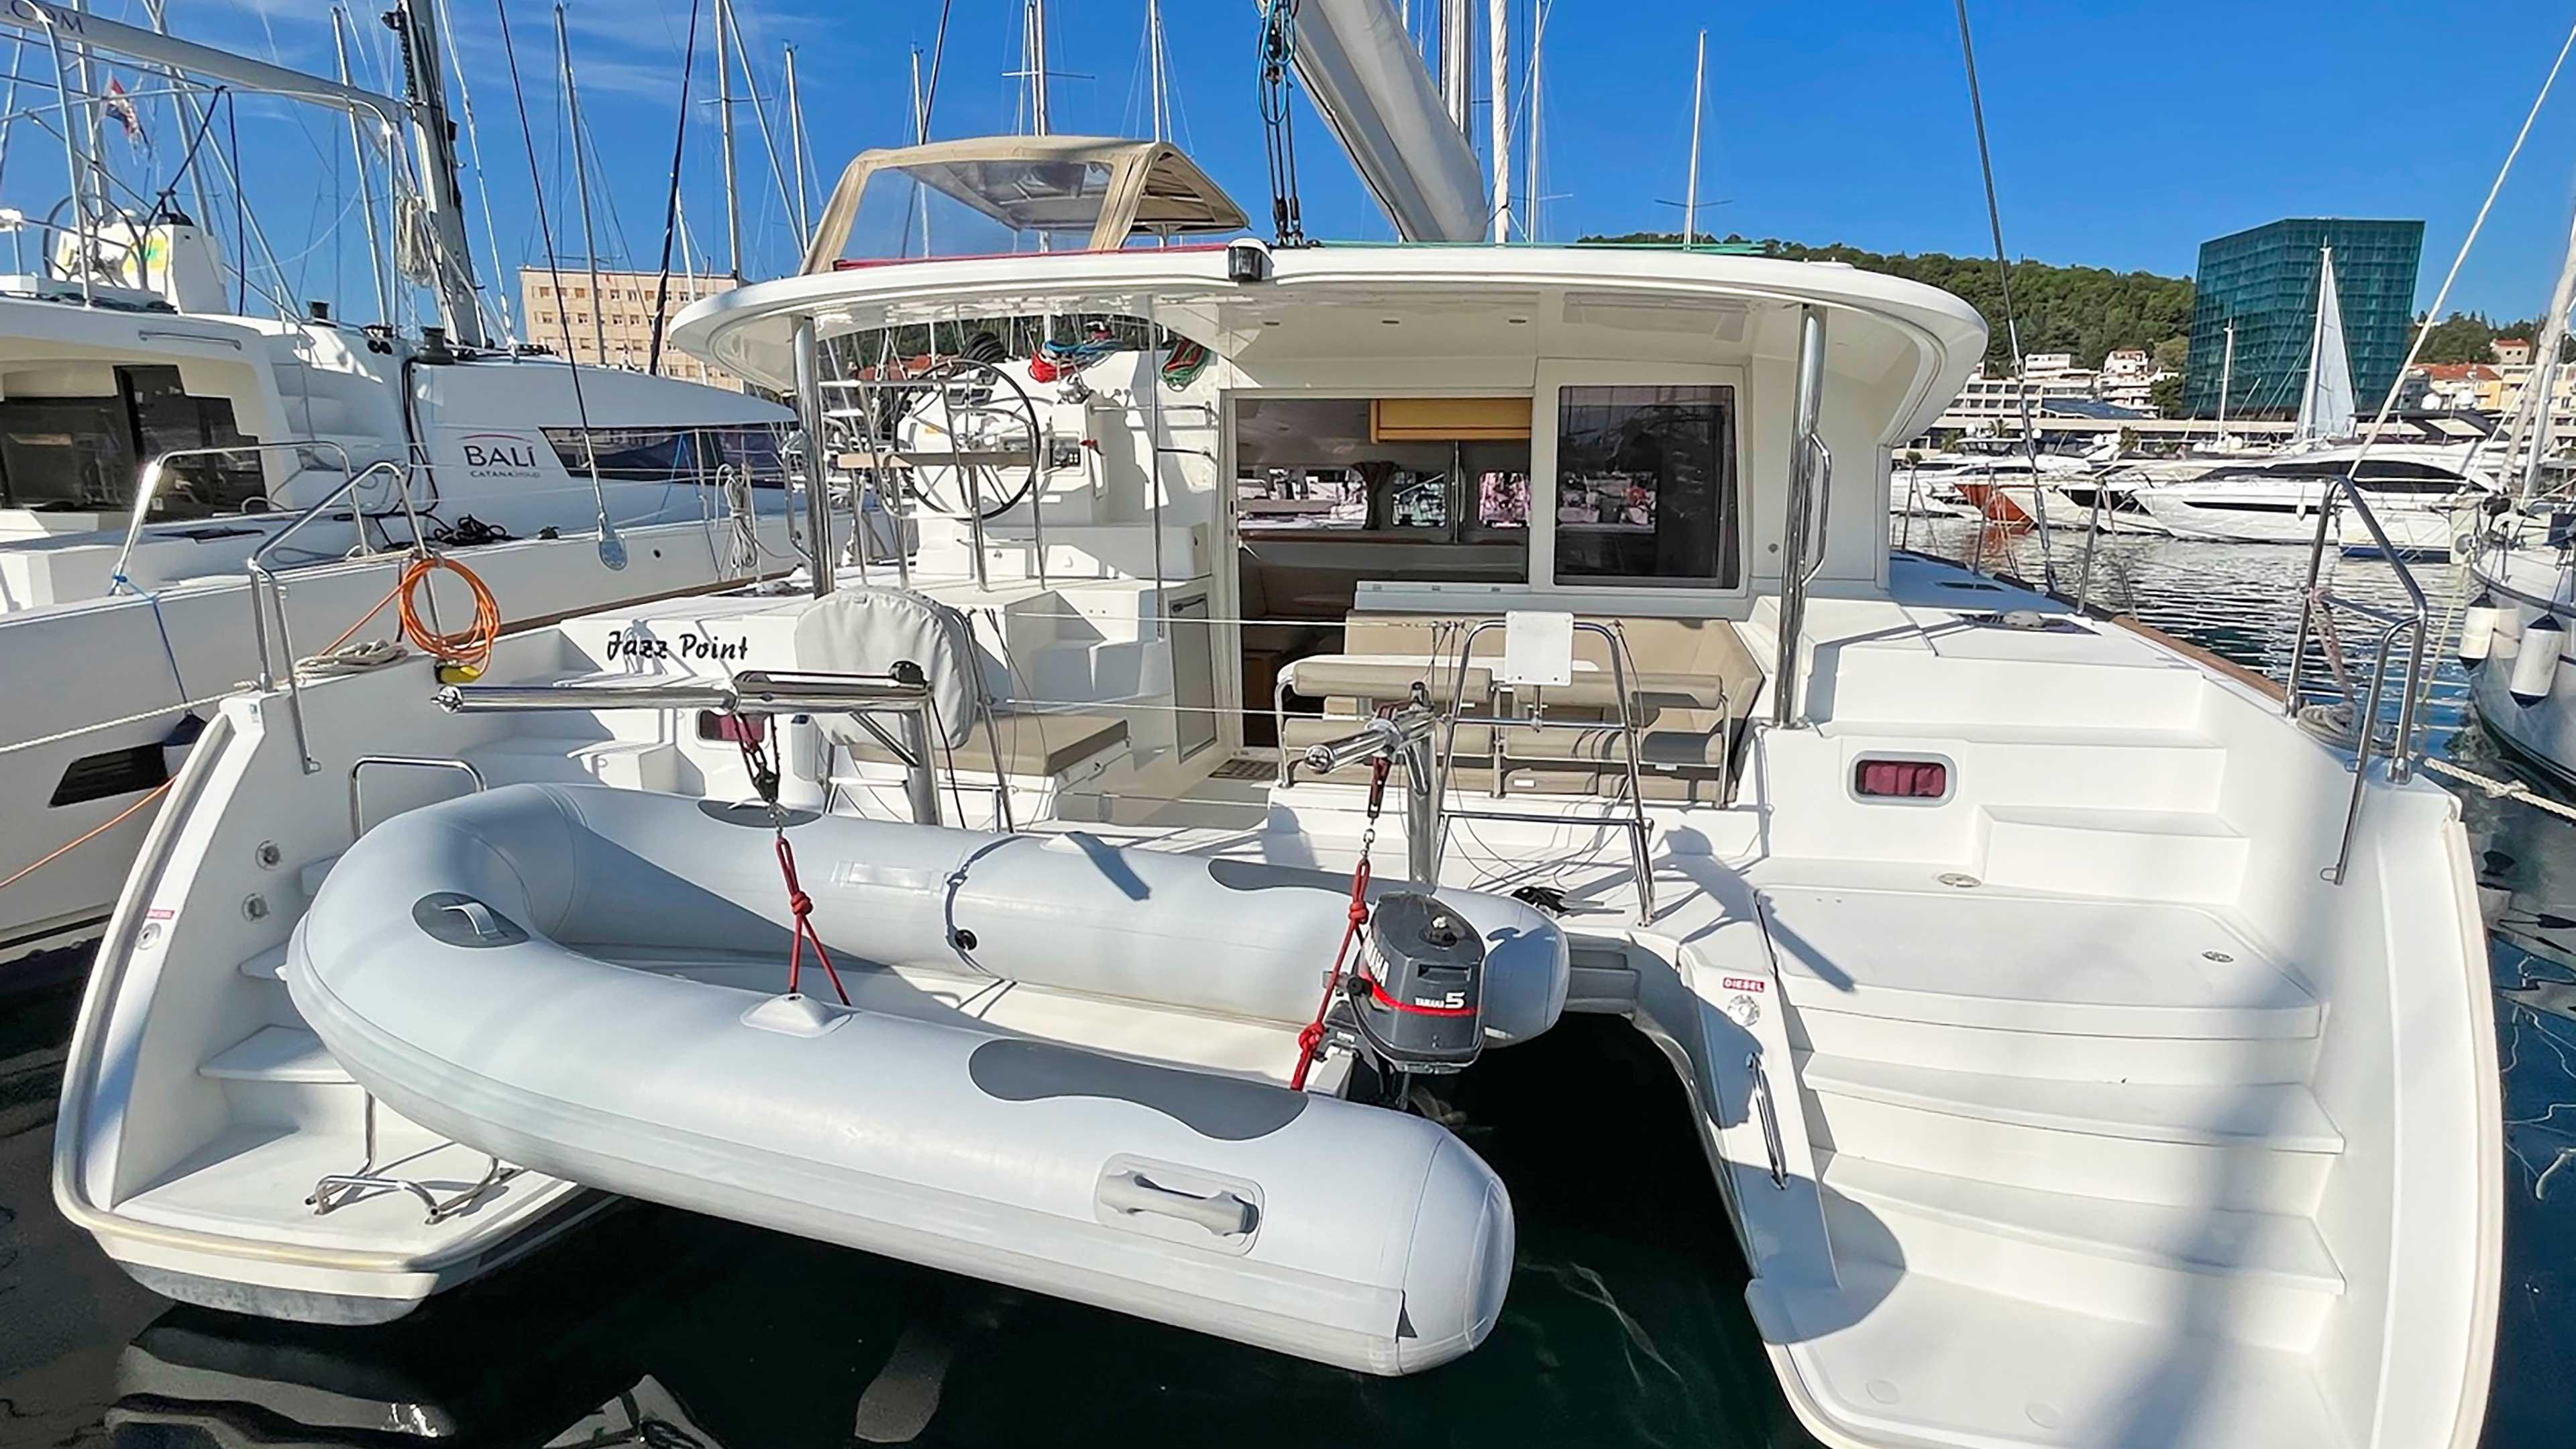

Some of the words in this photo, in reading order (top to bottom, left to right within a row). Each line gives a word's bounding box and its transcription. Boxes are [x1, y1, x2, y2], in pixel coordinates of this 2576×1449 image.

[607, 631, 667, 661] Jazz
[679, 633, 748, 659] Point
[1725, 978, 1763, 991] DIESEL
[1445, 991, 1465, 1008] 5
